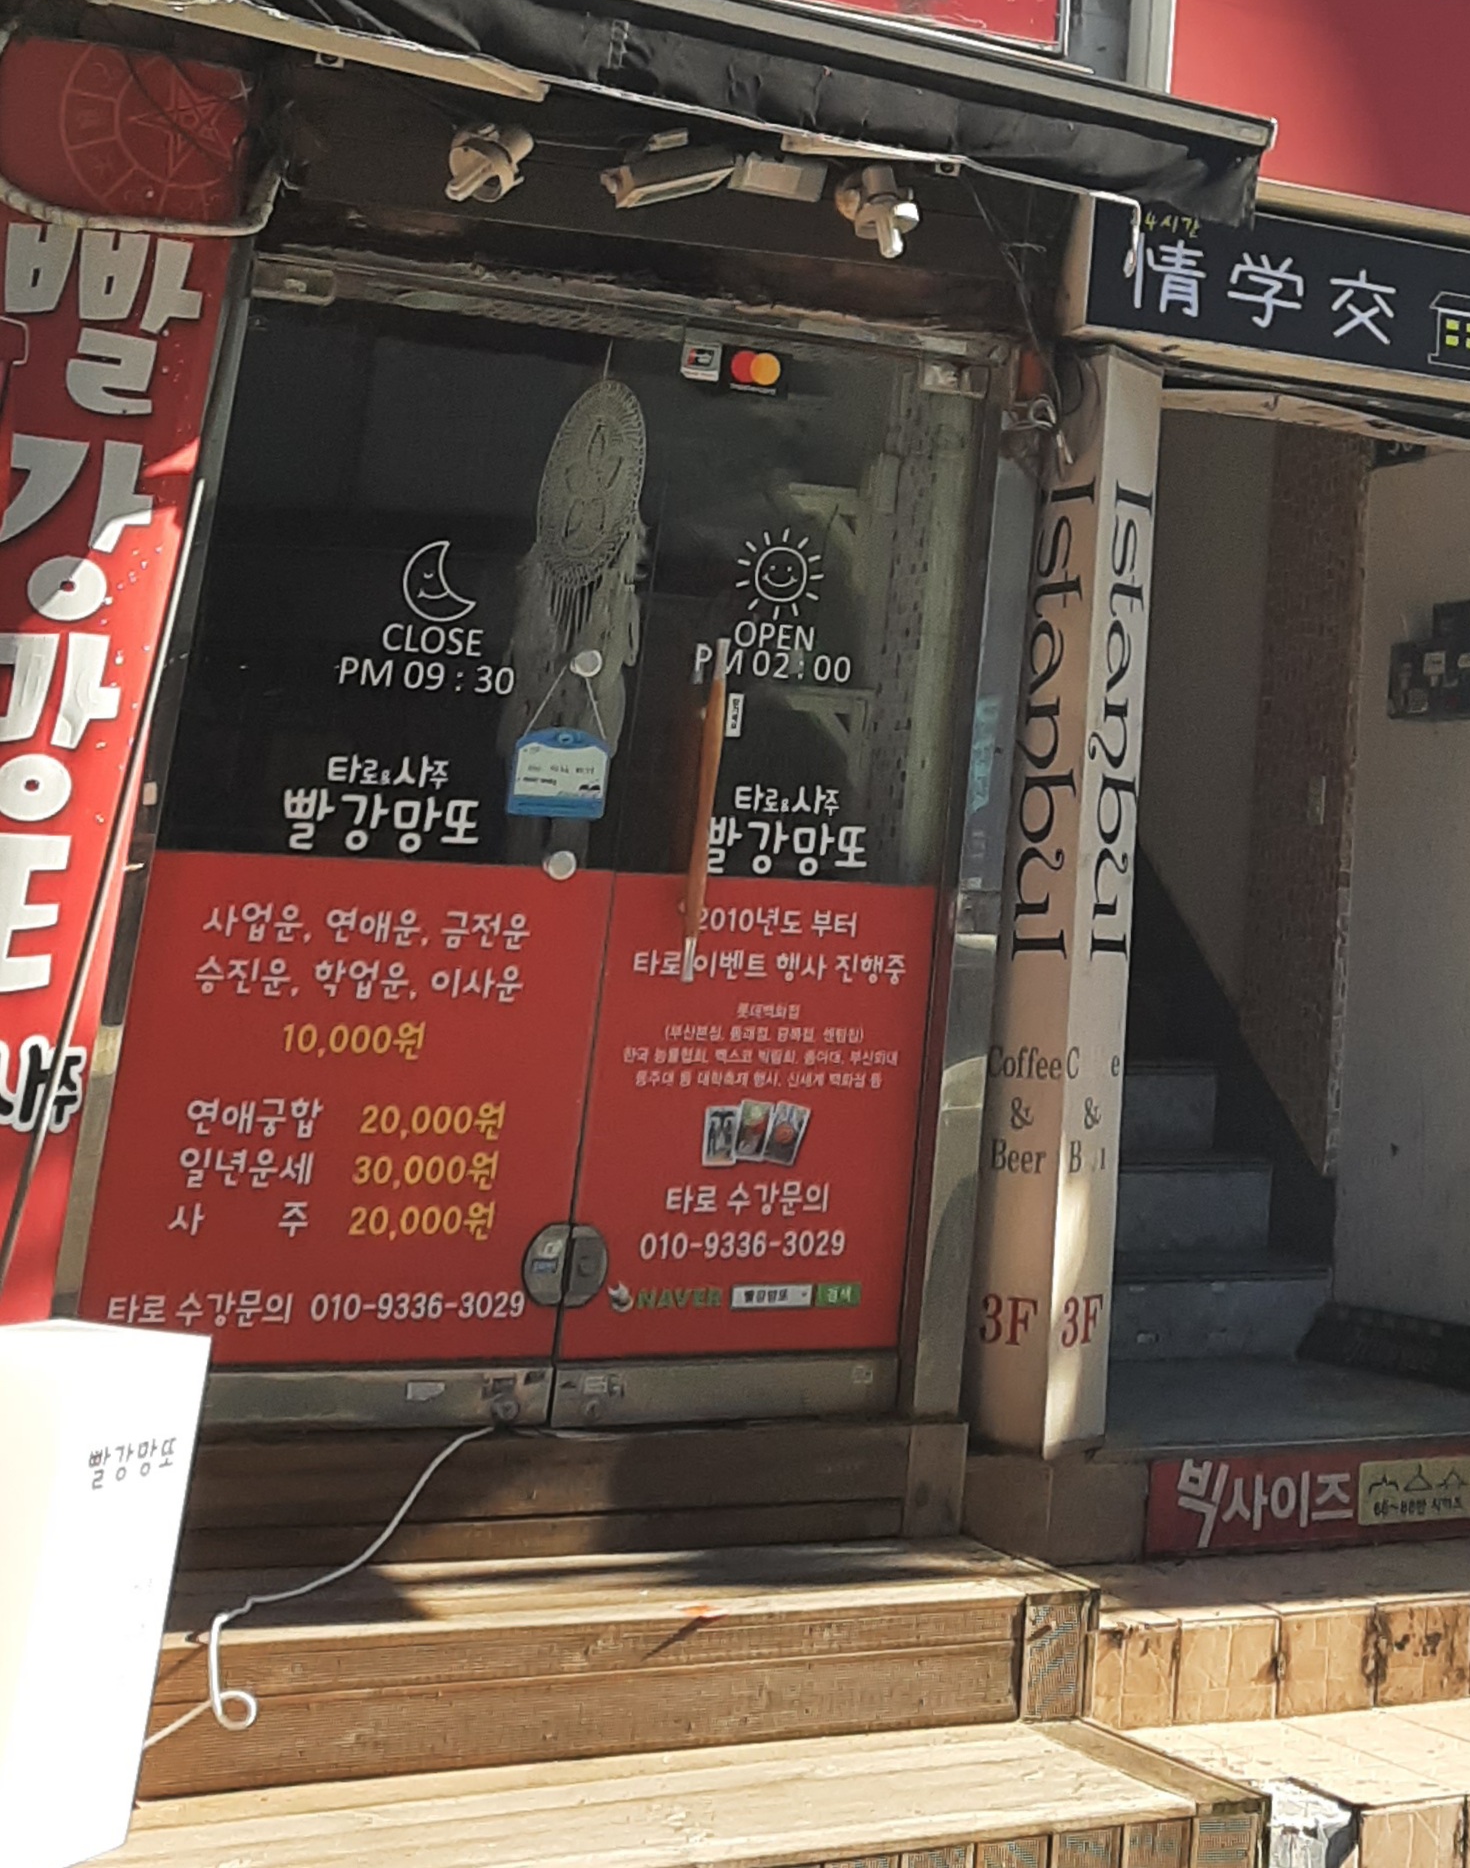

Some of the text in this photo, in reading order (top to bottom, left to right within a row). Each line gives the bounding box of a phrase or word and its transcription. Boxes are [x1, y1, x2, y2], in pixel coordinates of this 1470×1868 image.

[1142, 209, 1200, 238] 4시간
[382, 623, 484, 658] CLOSE
[734, 620, 815, 652] OPEN
[338, 655, 394, 689] PM
[1012, 476, 1097, 961] Istanbul
[1087, 479, 1154, 961] Istanbul
[327, 755, 450, 790] 타로&사주
[734, 784, 840, 817] 타로&사주
[283, 787, 480, 854] 빨강망또
[203, 902, 531, 951] 사업운, 연애운, 금전운
[810, 909, 858, 938] 부터
[195, 955, 524, 1003] 승진운, 학업운, 이사운
[632, 950, 907, 986] 타로 이벤트 행사 진행중
[283, 1021, 427, 1061] 10,000원
[987, 1044, 1063, 1081] Coffee
[186, 1097, 506, 1141] 연애궁합 20,000원
[1010, 1096, 1034, 1131] &
[1083, 1096, 1102, 1131] &
[179, 1147, 499, 1191] 일년운세 30,000원
[990, 1137, 1048, 1175] Beer
[665, 1181, 830, 1216] 타로 수강문의
[347, 1200, 496, 1241] 20,000원
[640, 1229, 846, 1260] 010-9336-3029
[107, 1290, 527, 1328] 타로 수강문의 010-9336-3029
[636, 1287, 722, 1310] NAVER
[979, 1293, 1039, 1347] 3F
[1061, 1293, 1104, 1349] 3F
[88, 1436, 177, 1491] 빨강망또
[1175, 1458, 1355, 1549] 빅사이즈
